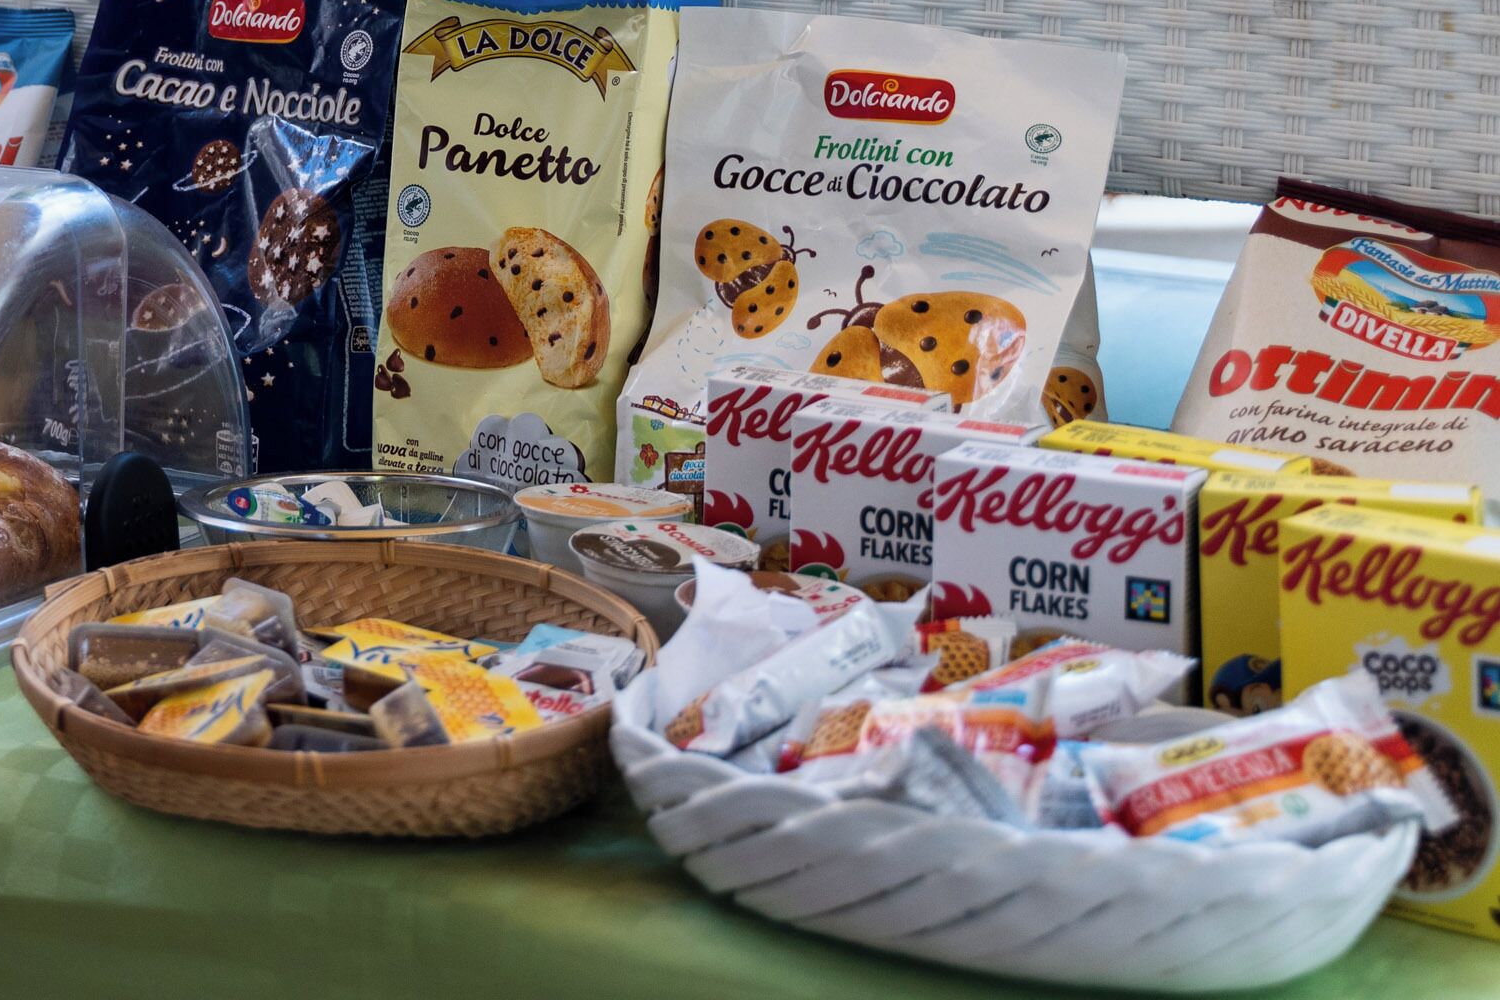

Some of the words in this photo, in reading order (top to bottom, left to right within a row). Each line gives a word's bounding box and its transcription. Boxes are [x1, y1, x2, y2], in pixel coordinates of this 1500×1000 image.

[211, 0, 301, 33] Dolciando
[153, 45, 204, 71] Frollini
[205, 57, 226, 73] con
[456, 29, 500, 60] LA
[509, 26, 595, 71] DOLCE
[114, 58, 217, 109] Cacao
[219, 84, 237, 112] e
[243, 76, 362, 126] Nocciole
[830, 80, 950, 114] Dolciando
[474, 113, 550, 143] Dolce
[418, 125, 601, 185] Panetto
[813, 135, 902, 163] Frollini
[906, 147, 954, 167] con
[713, 153, 825, 197] Gocce
[827, 175, 843, 193] di
[846, 163, 1051, 214] Cioccolato
[1351, 238, 1416, 278] Fantasie
[1336, 305, 1449, 360] DIVELLA
[1208, 345, 1500, 420] Ottimin
[1229, 403, 1262, 420] con
[1262, 400, 1334, 426] farina
[1337, 414, 1438, 435] integrale
[1443, 416, 1469, 431] di
[406, 438, 419, 447] con
[408, 448, 419, 458] da
[419, 450, 444, 462] galline
[478, 431, 506, 453] con
[512, 439, 565, 465] gocce
[1226, 425, 1307, 445] grano
[1315, 434, 1453, 454] saraceno
[415, 461, 444, 473] terra
[468, 448, 481, 470] di
[860, 505, 934, 543] CORN
[934, 466, 1185, 564] Kellogg's
[668, 530, 716, 557] CONAD
[860, 535, 933, 567] FLAKES
[1009, 556, 1090, 595] CORN
[1010, 585, 1089, 620] FLAKES
[526, 688, 584, 716] tella
